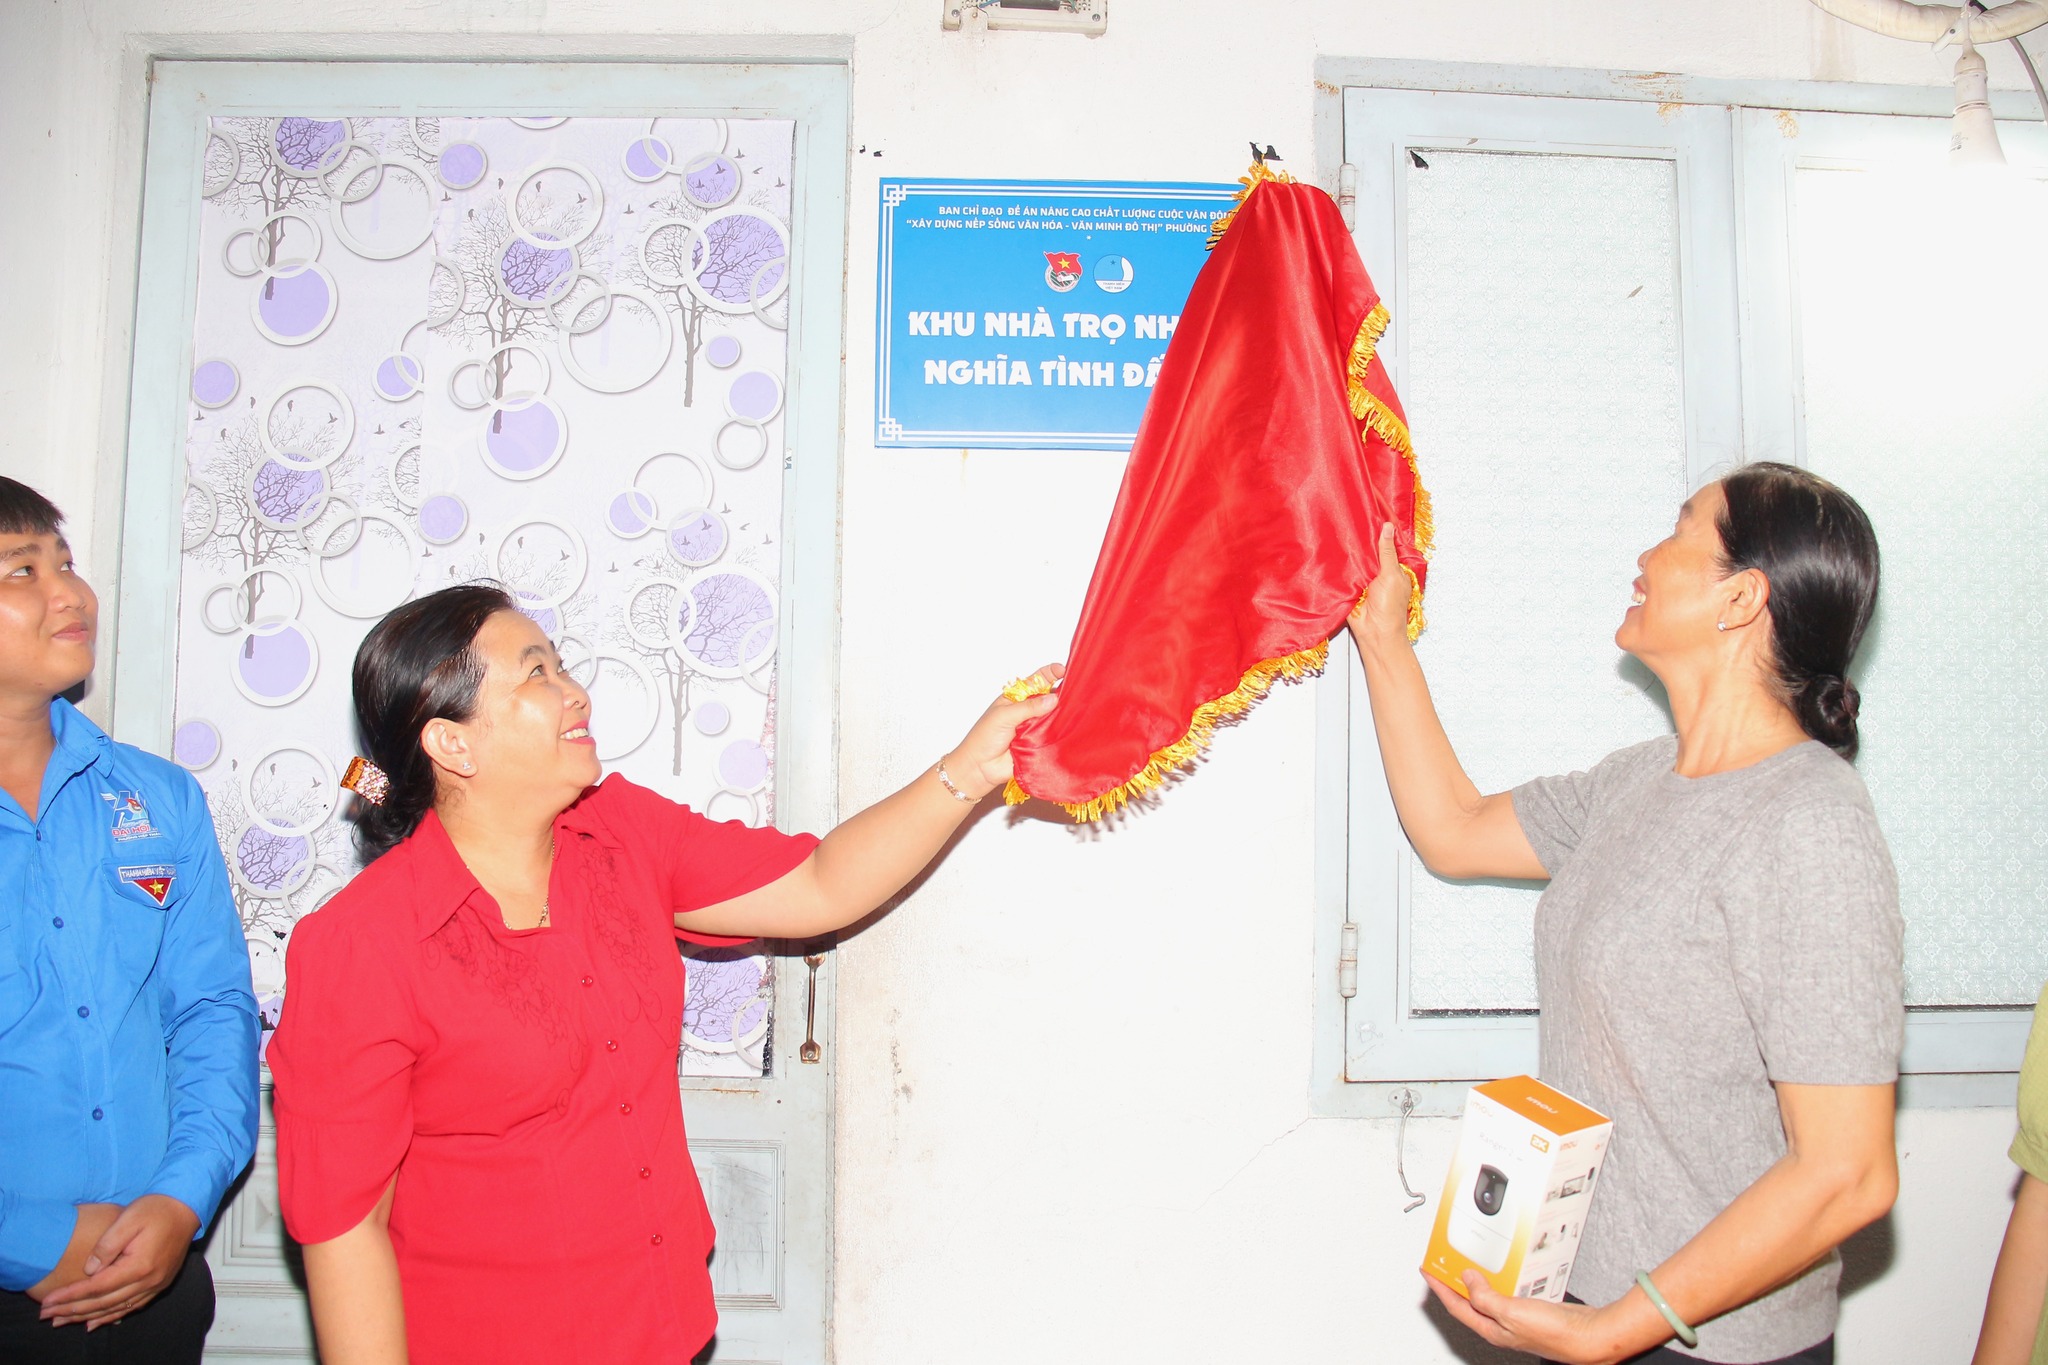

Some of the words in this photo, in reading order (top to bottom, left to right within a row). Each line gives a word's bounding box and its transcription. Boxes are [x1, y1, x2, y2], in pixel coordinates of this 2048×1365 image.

[934, 219, 963, 230] DỰNG
[965, 217, 986, 229] NẾP
[988, 217, 1015, 229] SỐNG
[1017, 219, 1039, 230] VĂN
[1041, 219, 1063, 230] HÓA
[1071, 220, 1093, 230] VĂN
[1095, 222, 1122, 231] MINH
[1125, 220, 1139, 231] ĐÔ
[1165, 222, 1207, 233] PHƯỜNG
[939, 206, 960, 215] BAN
[962, 204, 979, 215] CHỈ
[982, 207, 1003, 217] ĐẠO
[1023, 205, 1038, 216] ÁN
[1040, 206, 1069, 217] NÂNG
[1071, 208, 1092, 217] CAO
[1093, 205, 1120, 217] CHẤT
[1122, 208, 1156, 220] LƯỢNG
[1158, 209, 1184, 220] CUỘC
[1186, 209, 1207, 221] VẬN
[907, 311, 976, 337] KHU
[983, 306, 1056, 338] NHÀ
[1062, 313, 1127, 345] TRỌ
[1133, 314, 1180, 340] NH
[923, 353, 1033, 386] NGHĨA
[1039, 355, 1115, 387] TÌNH
[1122, 353, 1166, 388] ĐẤ
